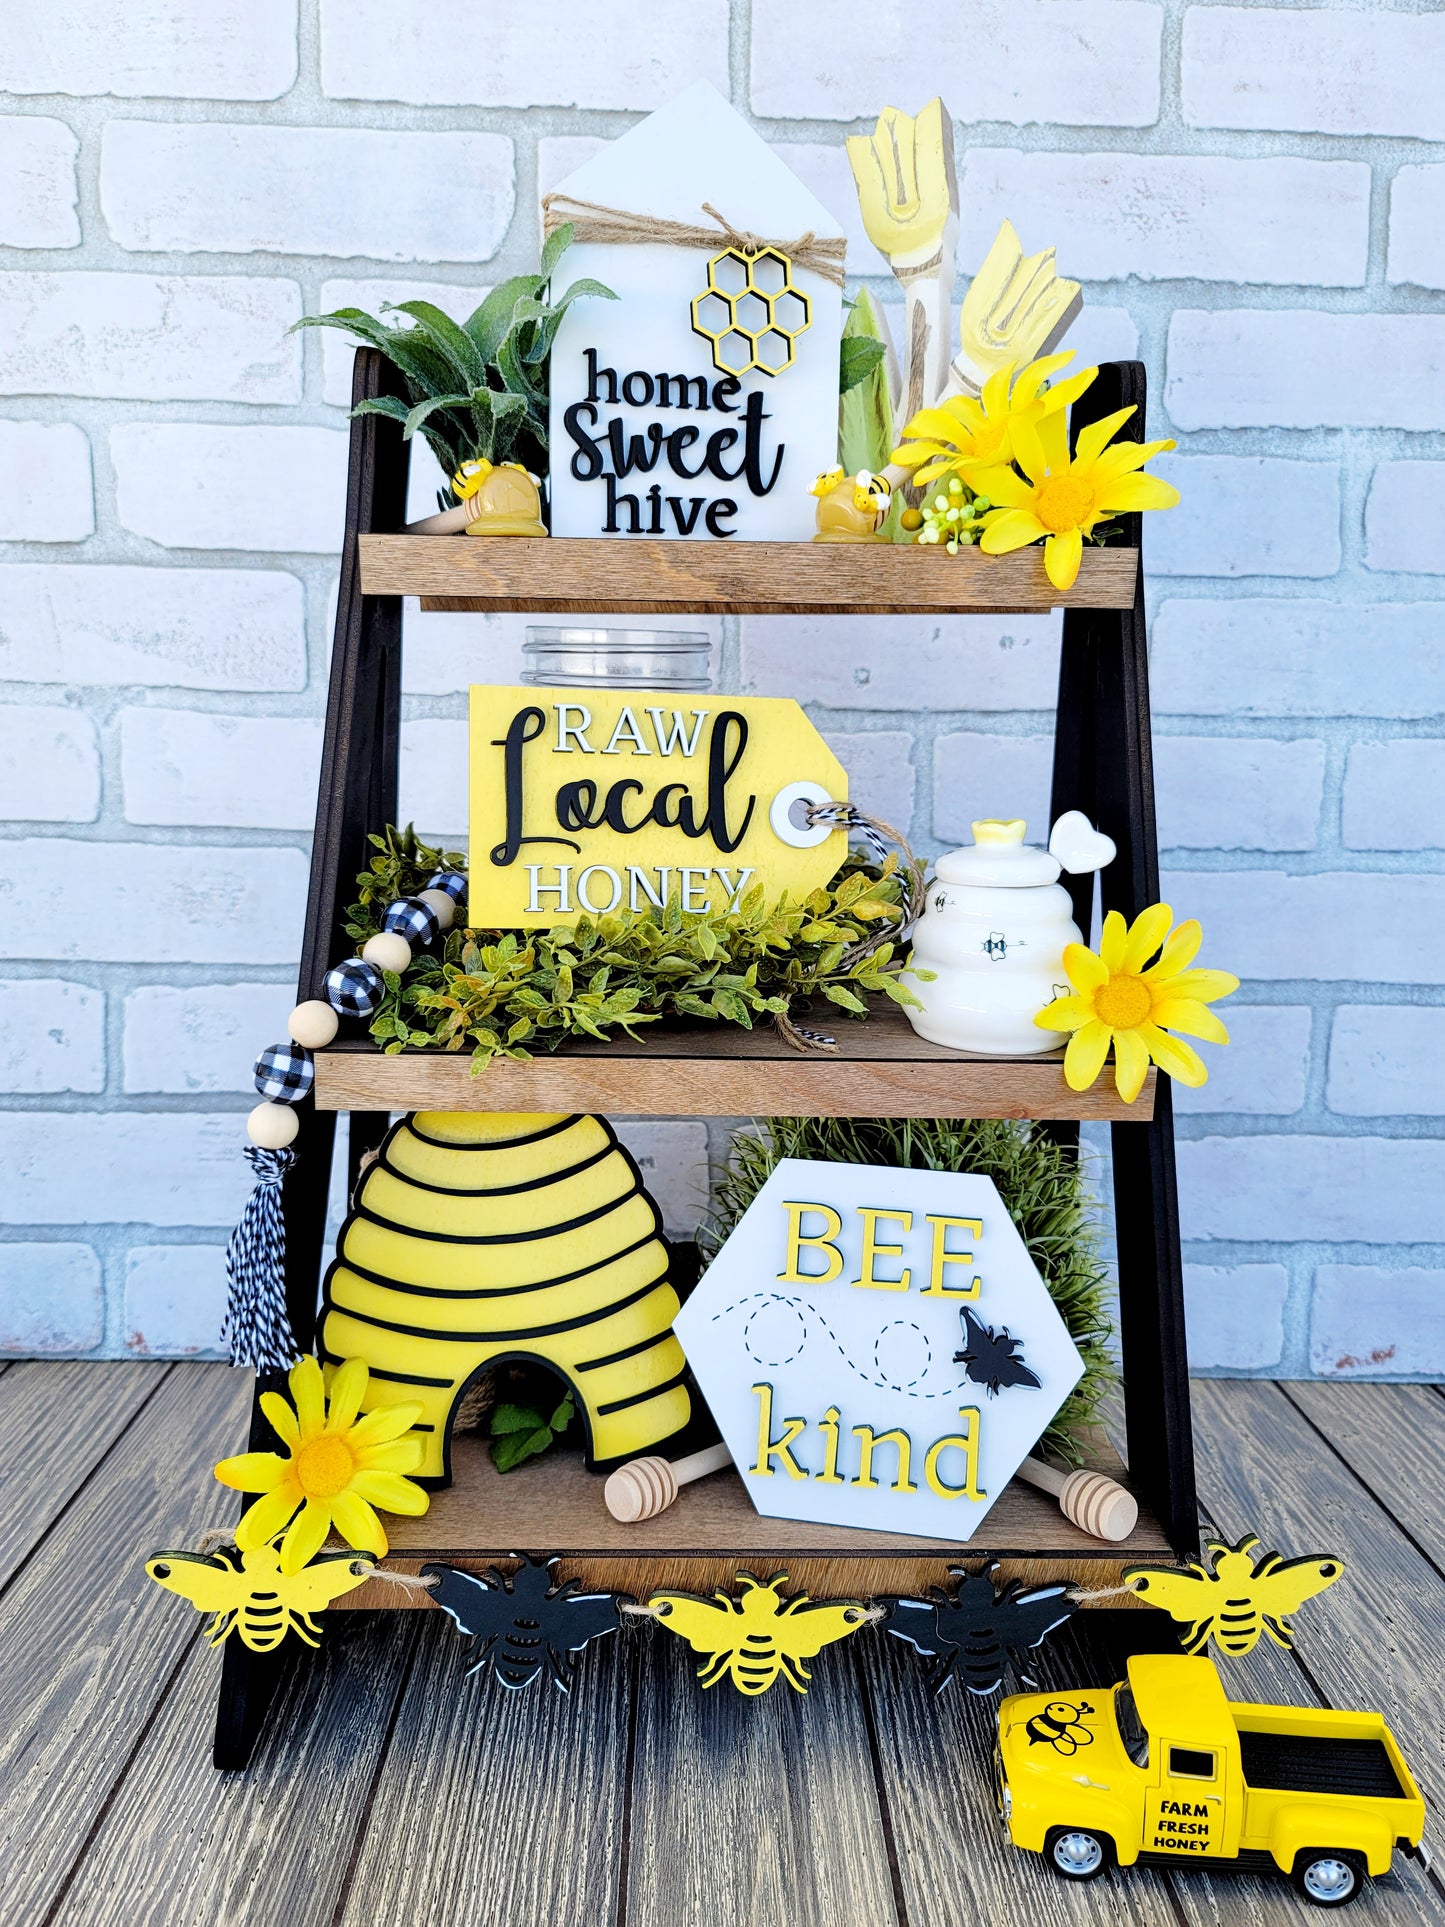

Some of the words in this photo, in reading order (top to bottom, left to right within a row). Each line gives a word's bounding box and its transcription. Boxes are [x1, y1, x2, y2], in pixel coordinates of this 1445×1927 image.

[583, 348, 741, 412] home
[601, 473, 738, 538] hive
[552, 704, 709, 757] RAW
[490, 706, 756, 866] Local
[523, 864, 755, 914] HONEY
[776, 1200, 983, 1301] BEE
[748, 1381, 987, 1503] kind
[1158, 1820, 1209, 1835] FRESH
[1160, 1800, 1209, 1817] FARM
[1154, 1836, 1210, 1851] HONEY
